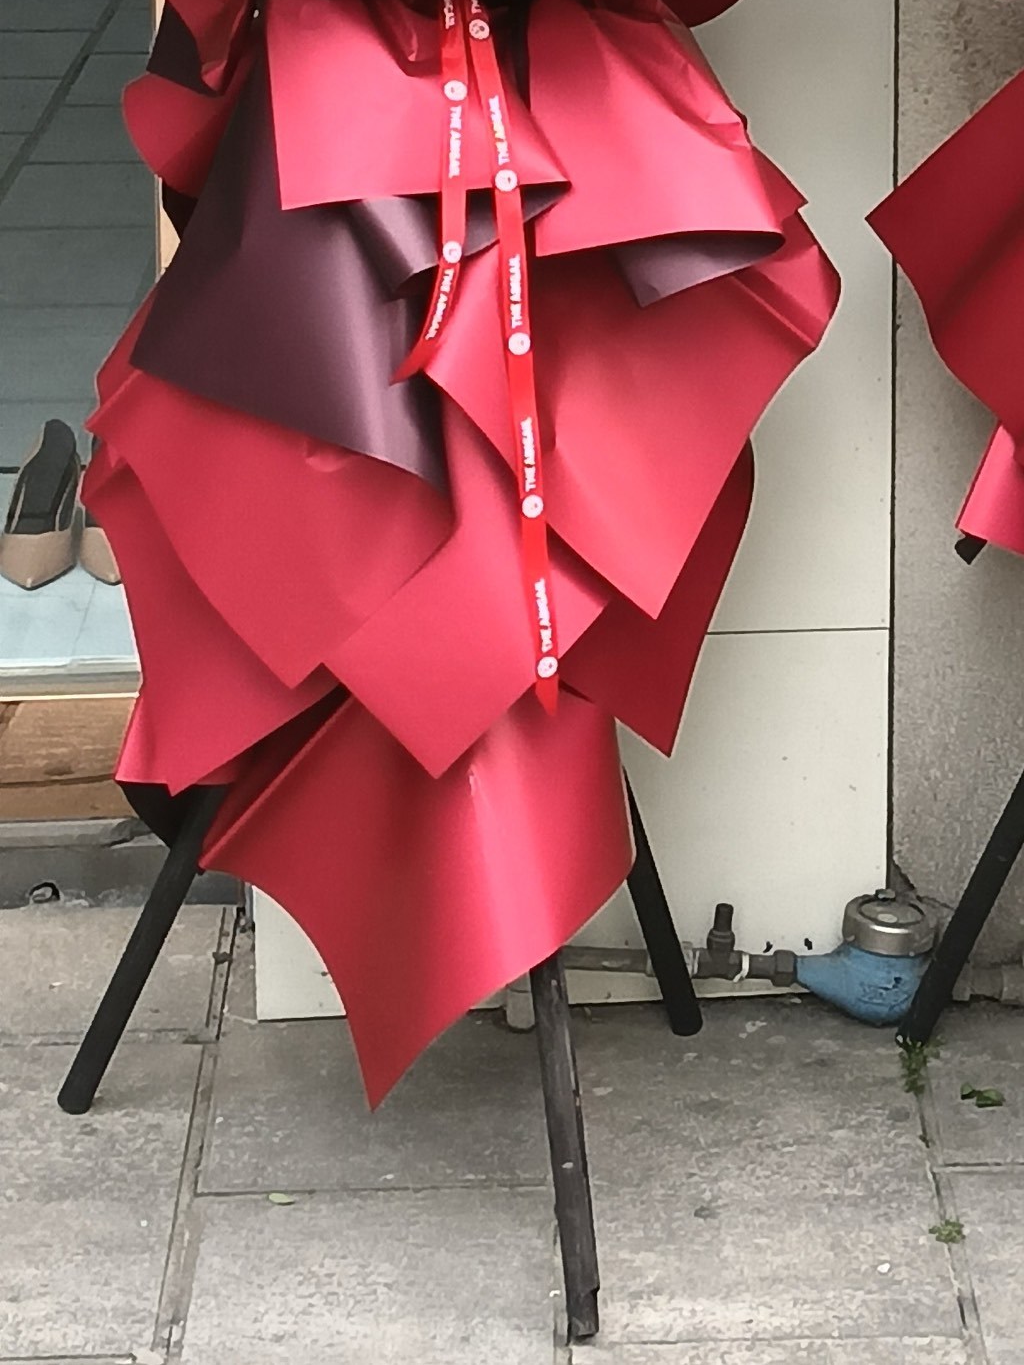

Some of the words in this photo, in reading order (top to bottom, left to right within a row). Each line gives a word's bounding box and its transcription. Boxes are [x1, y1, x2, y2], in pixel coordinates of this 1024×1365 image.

[449, 105, 462, 130] THE
[496, 140, 510, 166] THE
[441, 268, 454, 293] THE
[510, 303, 523, 329] THE
[525, 466, 537, 492] THE
[540, 628, 553, 653] THE
